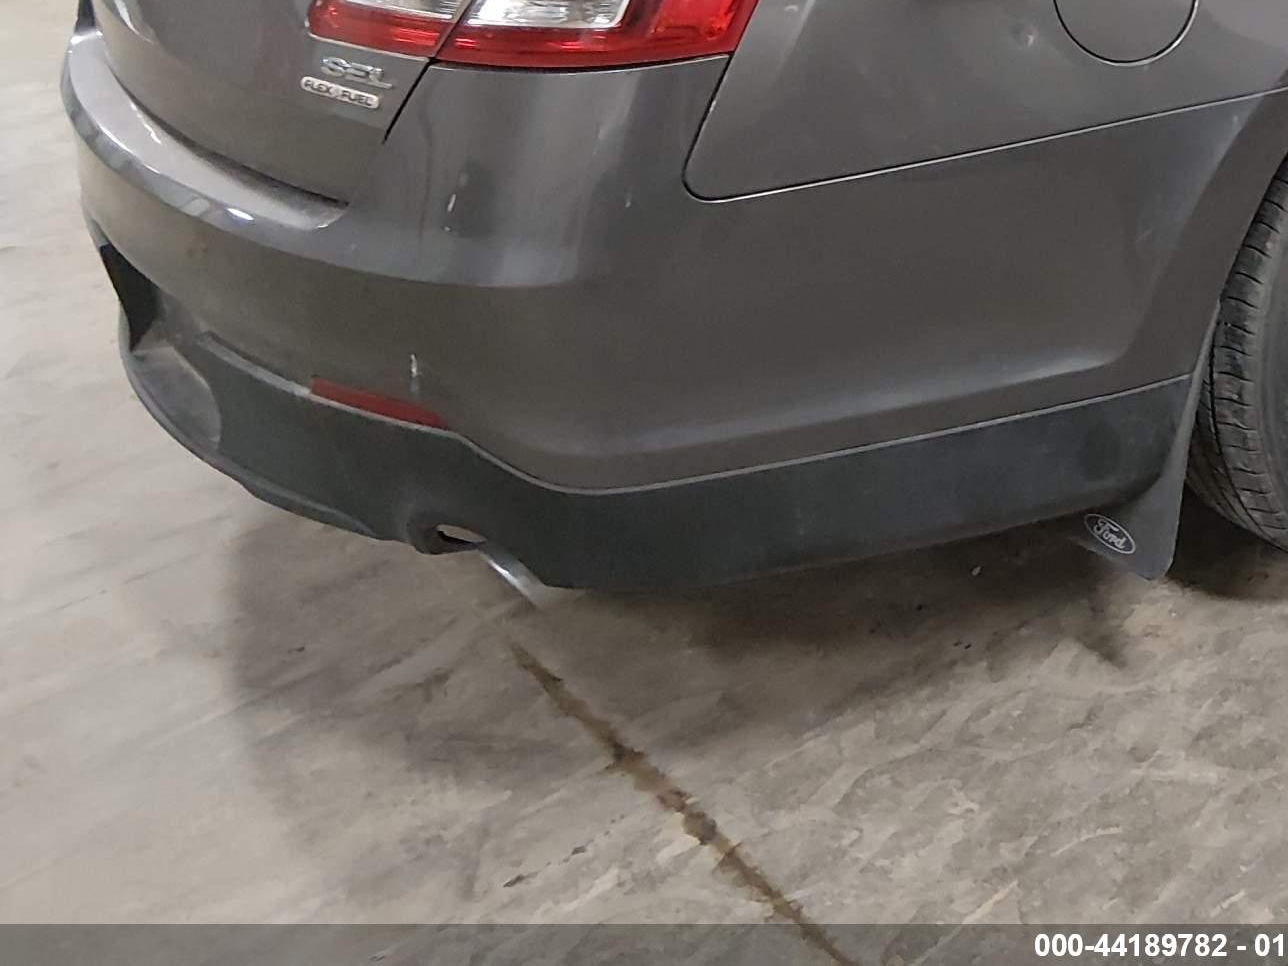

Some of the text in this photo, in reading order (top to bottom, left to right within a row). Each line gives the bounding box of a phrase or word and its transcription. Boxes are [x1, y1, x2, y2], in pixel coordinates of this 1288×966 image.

[320, 56, 393, 90] SEL
[303, 79, 374, 107] FLEX FUEL
[1093, 518, 1127, 549] Ford
